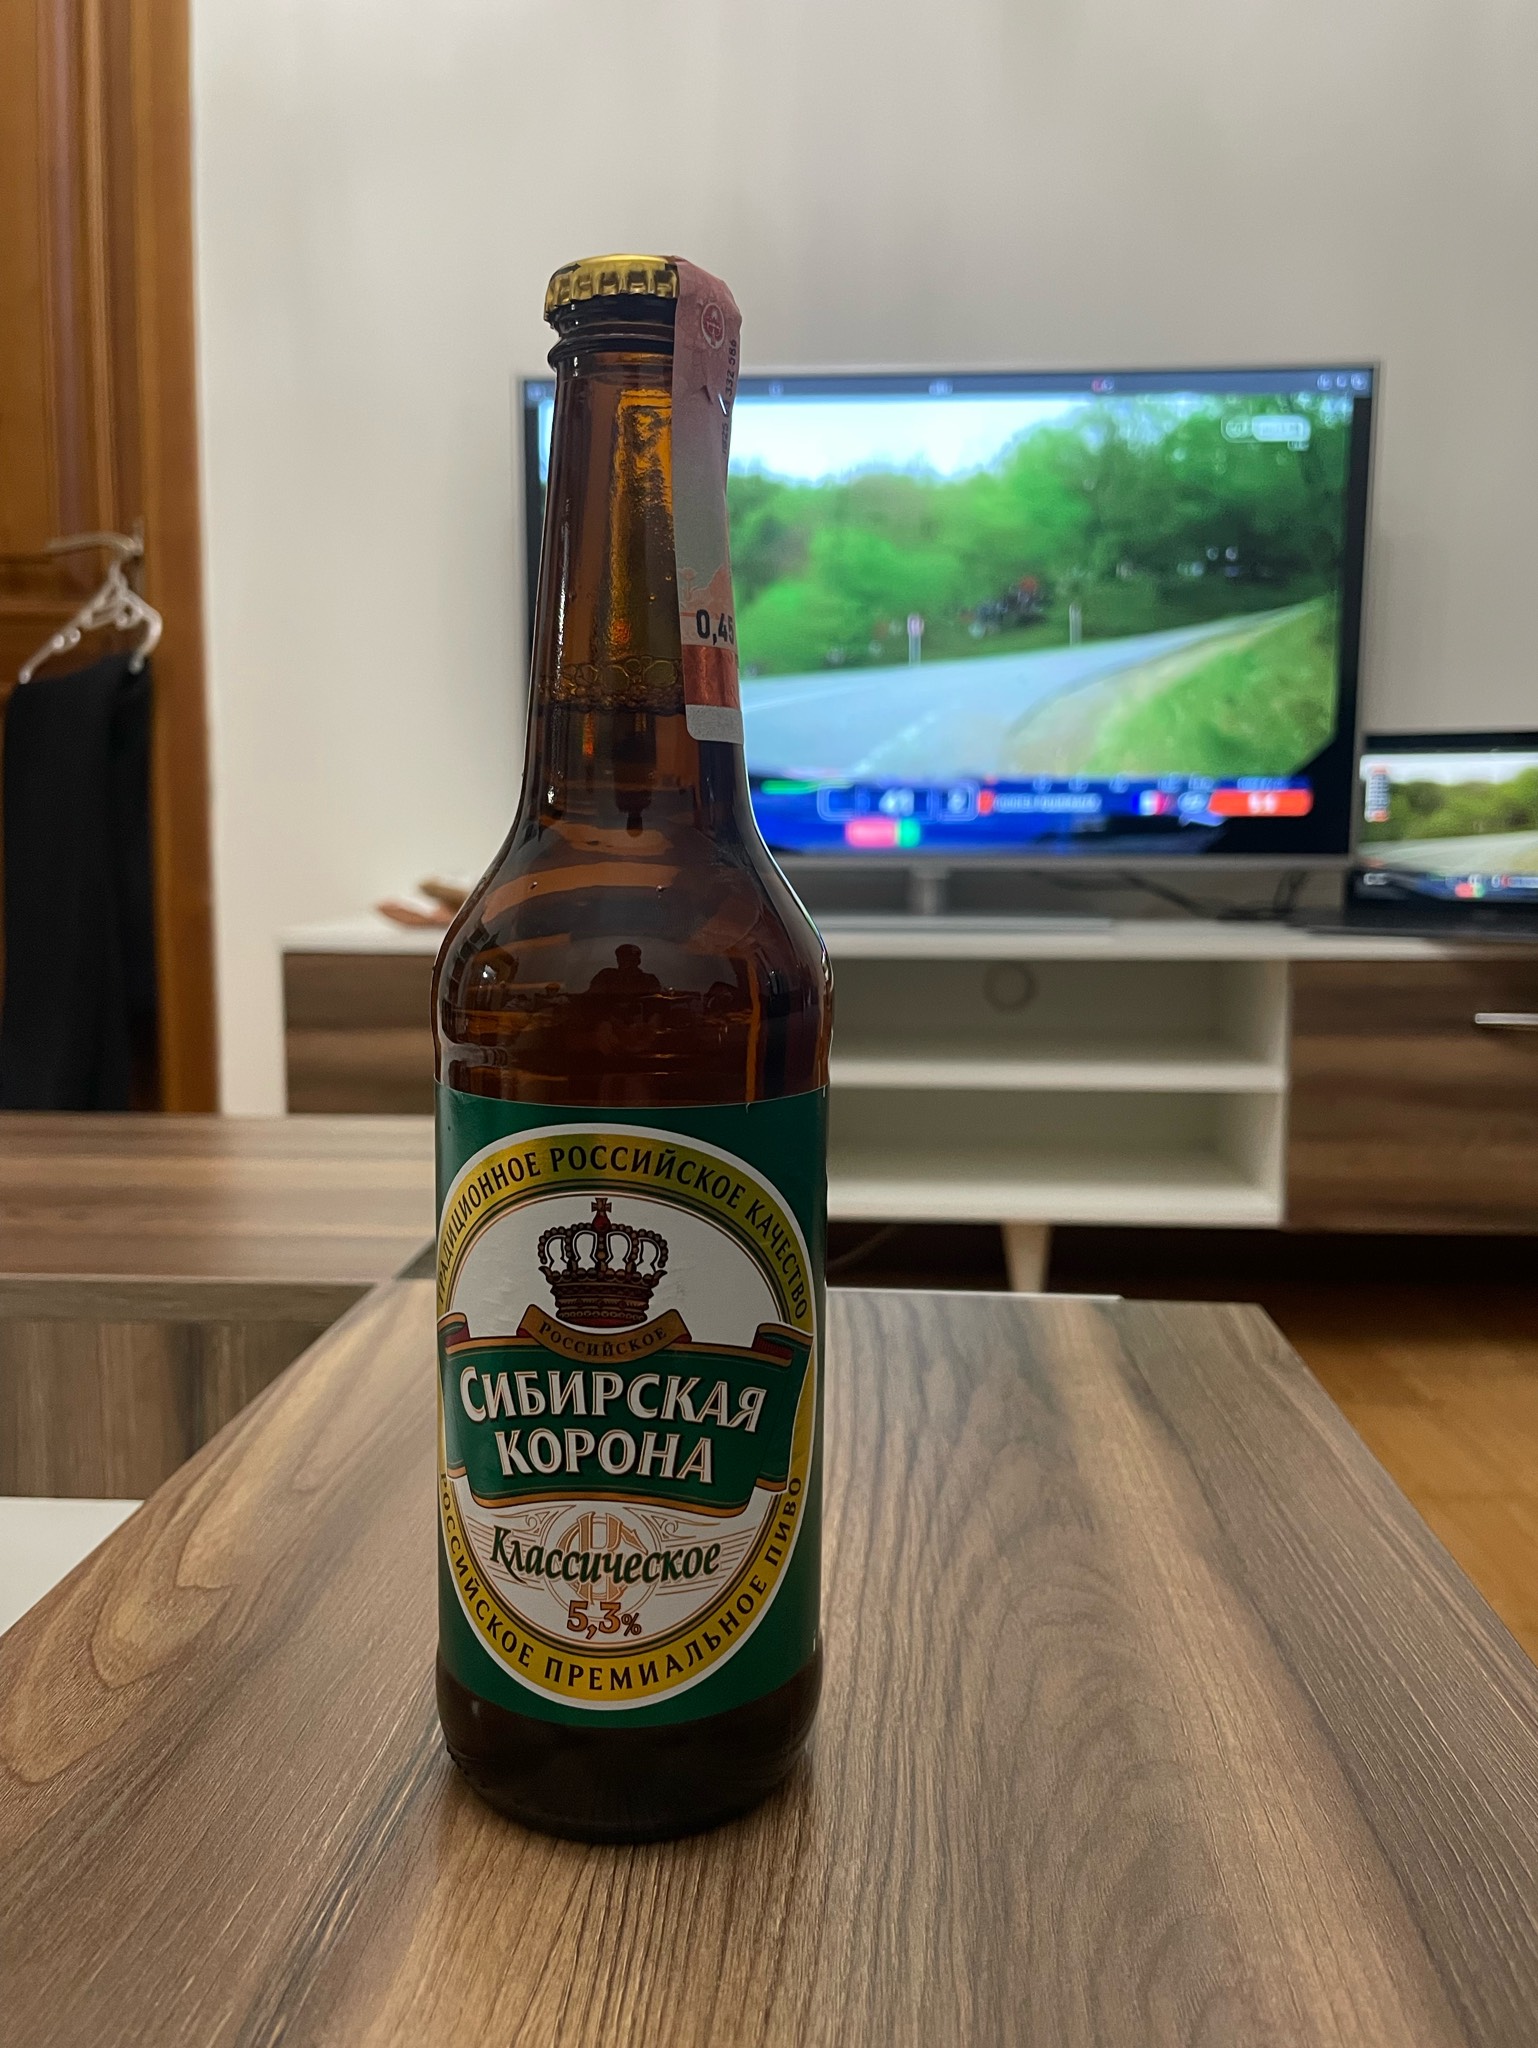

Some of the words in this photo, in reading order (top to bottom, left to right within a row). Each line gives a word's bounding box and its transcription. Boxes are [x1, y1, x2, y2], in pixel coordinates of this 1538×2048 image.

[696, 609, 735, 646] 0,45
[550, 1145, 747, 1209] РОССИЙСКОЕ
[745, 1199, 809, 1321] КАЧЕСТВО
[539, 1321, 667, 1357] РОССИЙСКОЕ
[460, 1366, 767, 1433] СИБИРСКАЯ
[494, 1427, 713, 1484] КОРОНА
[441, 1473, 535, 1668] РОССИЙСКОЕ
[544, 1575, 768, 1691] ПРЕМИАЛЬНОЕ
[766, 1476, 802, 1568] ПИВО
[490, 1525, 721, 1585] Классическое
[566, 1600, 642, 1640] 5,3%
